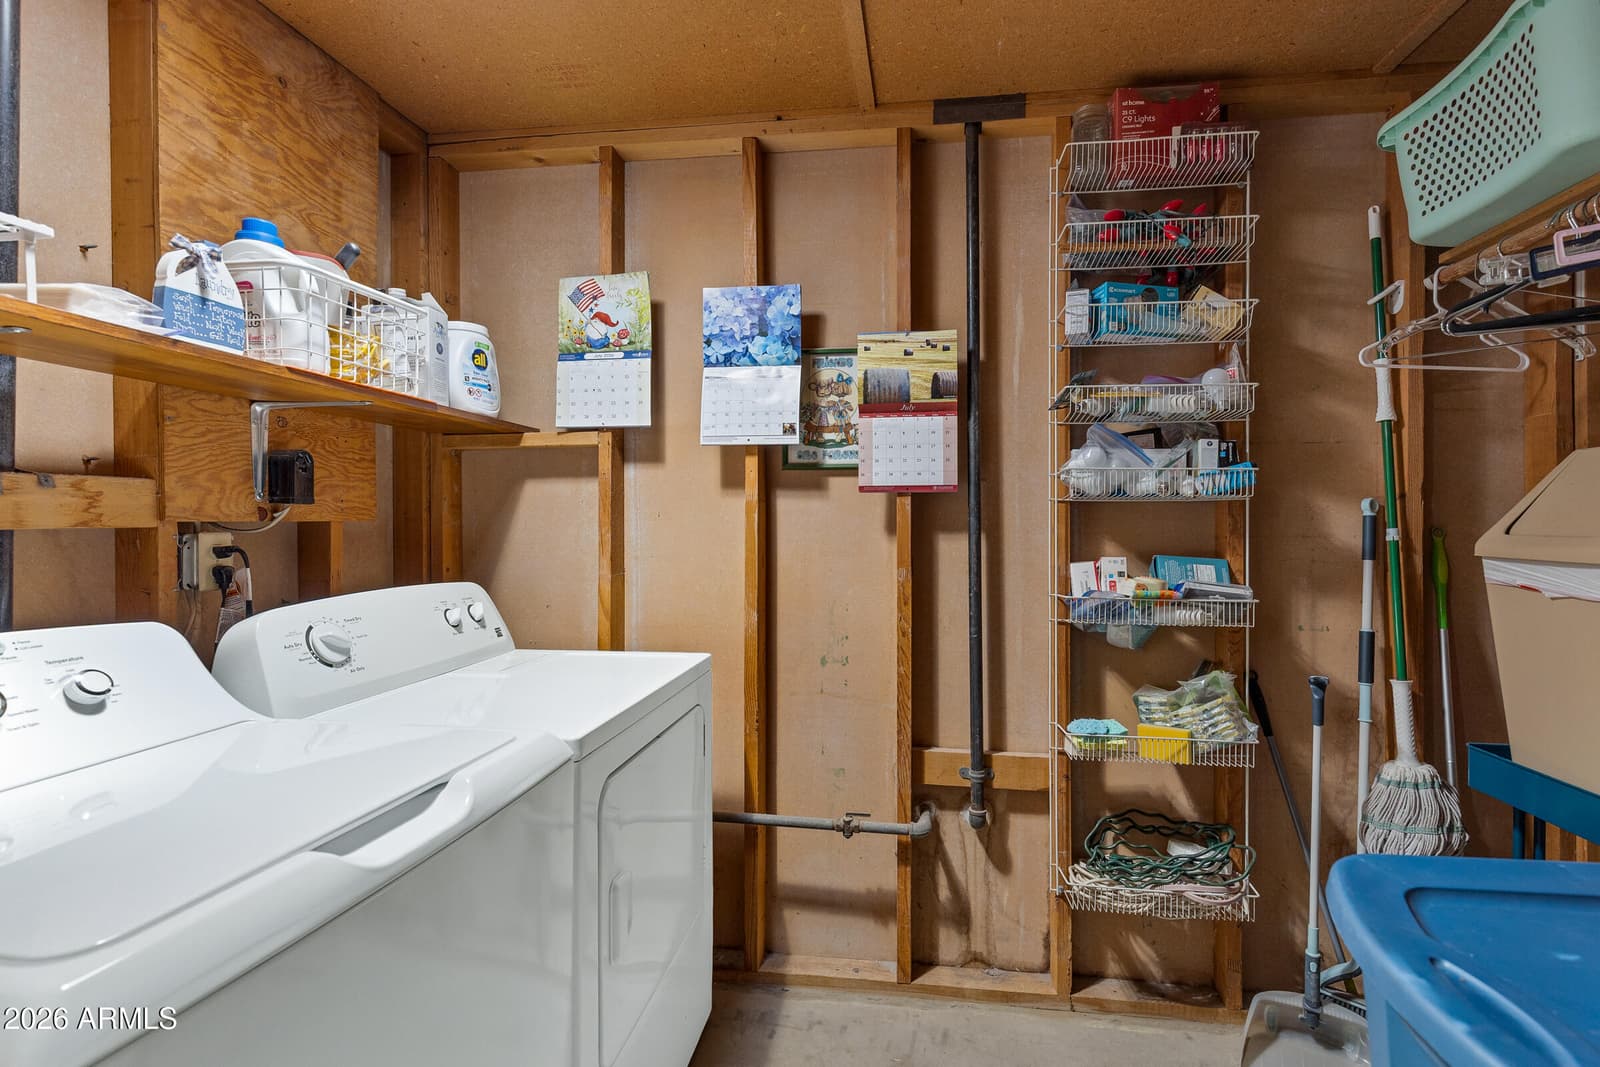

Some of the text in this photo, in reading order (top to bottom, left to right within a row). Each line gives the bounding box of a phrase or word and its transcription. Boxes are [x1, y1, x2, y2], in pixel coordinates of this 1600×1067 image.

[1122, 114, 1156, 124] C9 Lights
[474, 353, 487, 368] all
